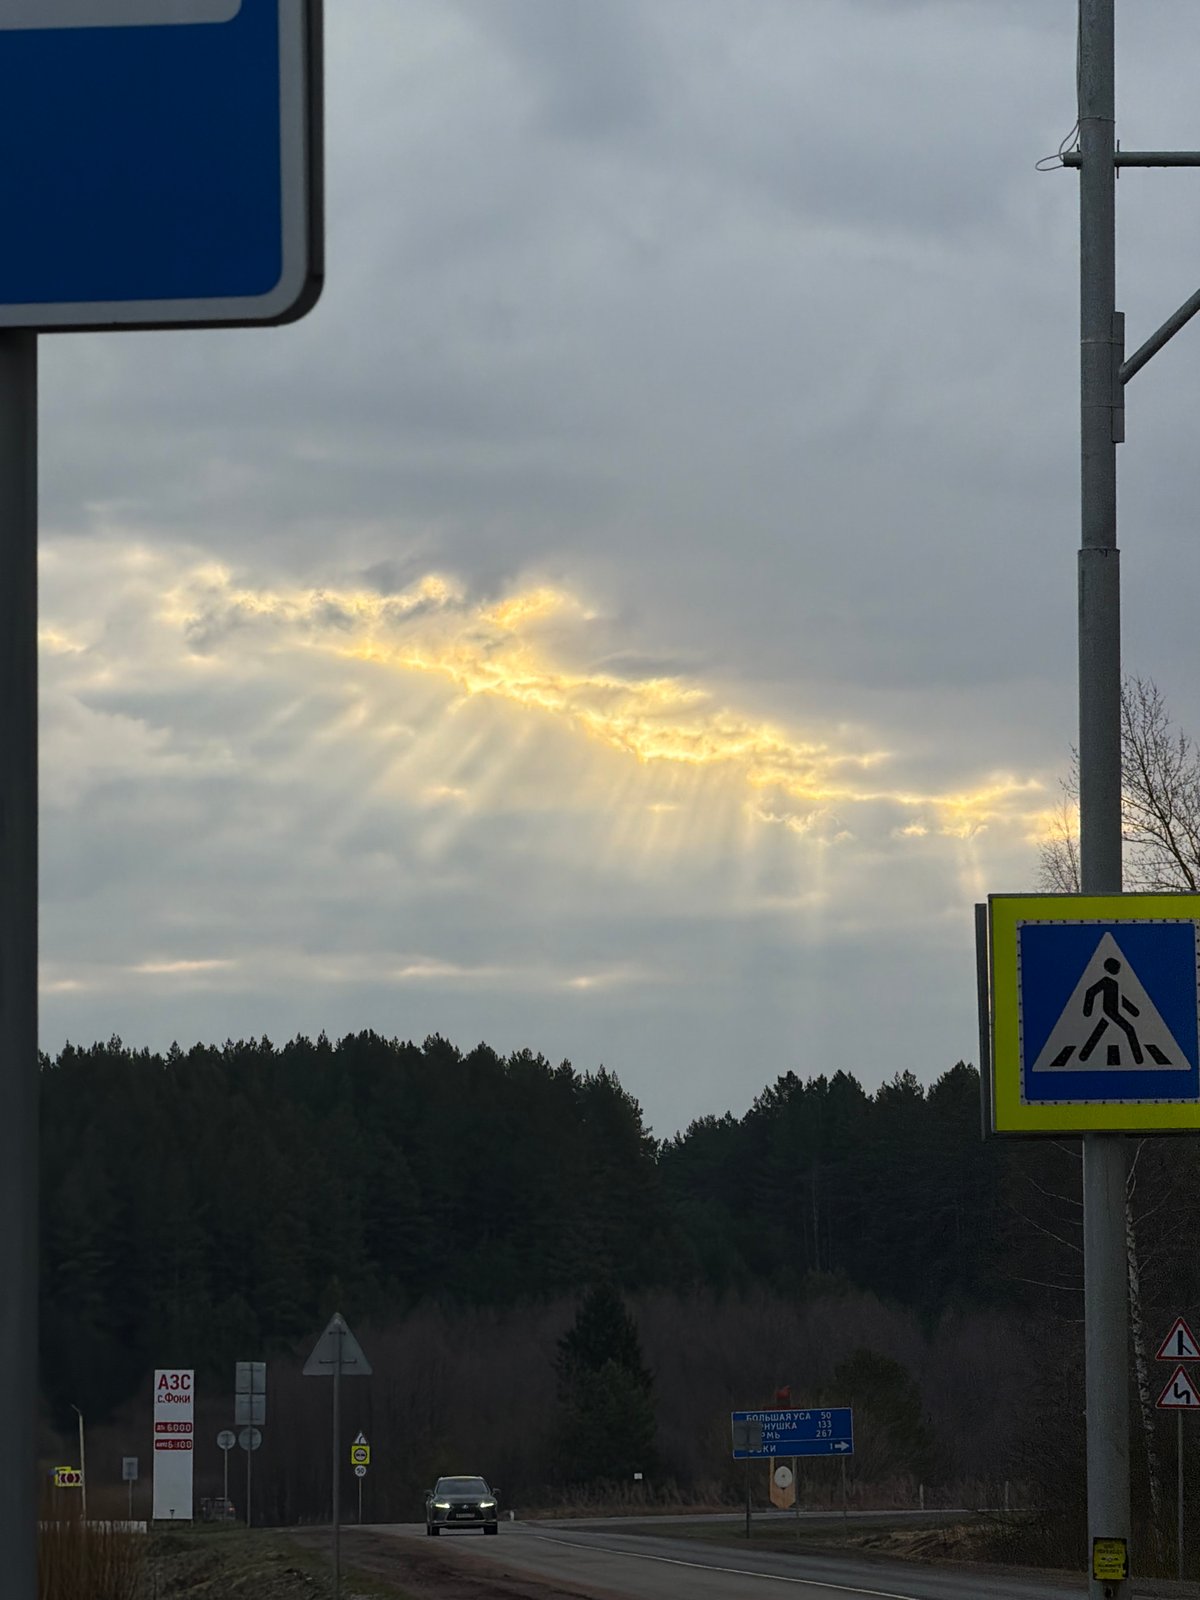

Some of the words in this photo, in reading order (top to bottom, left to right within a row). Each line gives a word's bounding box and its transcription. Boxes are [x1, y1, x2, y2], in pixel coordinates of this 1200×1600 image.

[158, 1374, 191, 1390] АЗС
[746, 1413, 792, 1422] БОЛЬШАЯ
[793, 1412, 811, 1420] УСА
[821, 1411, 832, 1419] 50
[818, 1420, 832, 1428] 133
[816, 1429, 832, 1437] 267
[749, 1444, 777, 1453] КИ
